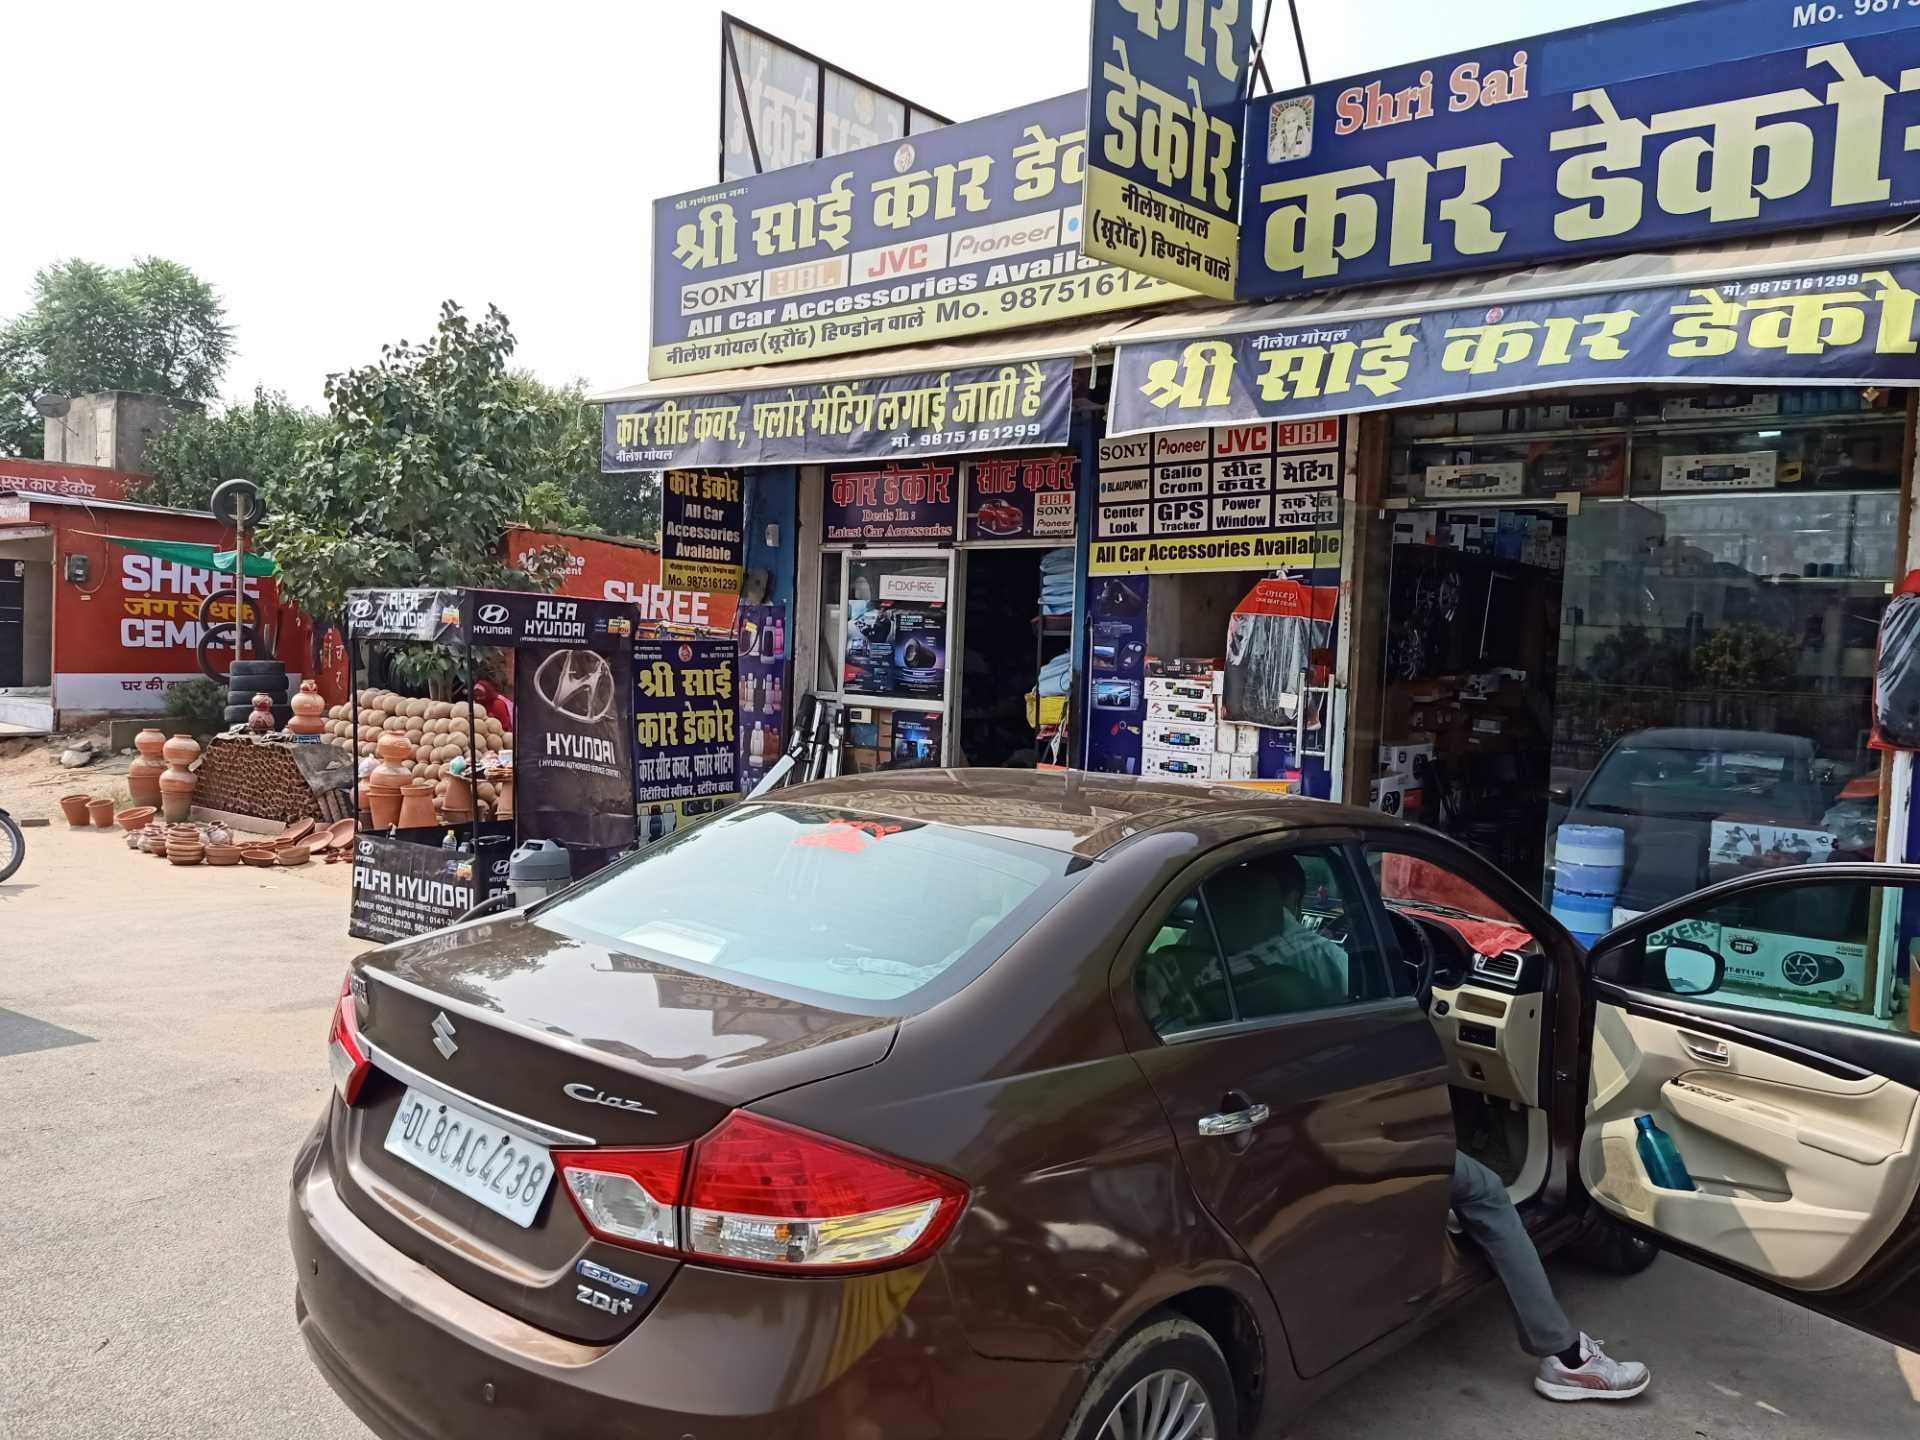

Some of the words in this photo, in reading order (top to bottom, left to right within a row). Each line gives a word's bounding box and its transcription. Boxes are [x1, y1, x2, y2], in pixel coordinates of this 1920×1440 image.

[1792, 3, 1844, 28] Mo.
[1335, 72, 1433, 136] Shri
[1448, 50, 1530, 113] Sai
[1103, 36, 1237, 212] डेकोर
[1259, 140, 1515, 280] कार
[1548, 41, 1920, 243] डेको
[672, 203, 738, 271] श्री
[752, 172, 856, 256] साई
[872, 156, 993, 230] कार
[1121, 182, 1167, 223] नीलेश
[1169, 204, 1211, 240] गोयल
[954, 225, 1056, 259] Pioneer
[868, 244, 928, 278] JVC
[1204, 257, 1231, 283] वाले
[769, 261, 842, 297] JBL
[683, 279, 759, 310] SONY
[687, 315, 722, 337] All
[728, 308, 777, 330] Car
[780, 272, 978, 323] Accessories
[1251, 333, 1300, 350] नीलेश
[1301, 328, 1351, 346] गोयल
[1723, 281, 1747, 298] मो.
[1748, 273, 1860, 296] 9875161299
[666, 344, 711, 365] नीलेश
[714, 335, 760, 357] गोयल
[888, 306, 926, 331] वाले
[937, 300, 989, 324] Mo.
[1139, 340, 1239, 409] श्री
[1255, 317, 1422, 402] साई
[1441, 308, 1641, 375] कार
[1667, 269, 1920, 358] डेको
[616, 414, 652, 448] कार
[653, 400, 692, 446] सीट
[693, 405, 746, 449] कवर,
[877, 372, 950, 434] लगाई
[952, 366, 1020, 424] जाती
[1020, 361, 1047, 417] है
[615, 448, 643, 463] नीलेश
[644, 449, 673, 461] गोयल
[919, 422, 1041, 447] 9875161299
[1217, 426, 1267, 454] JVC
[1281, 420, 1336, 446] JBL
[1099, 442, 1149, 462] SONY
[1157, 437, 1207, 456] Pioneer
[1160, 466, 1202, 480] Galio
[1221, 460, 1262, 478] सीट
[29, 479, 58, 493] कार
[59, 475, 97, 497] डेकोर
[669, 470, 699, 497] कार
[701, 468, 740, 503] डेकोर
[831, 471, 881, 507] कार
[881, 461, 955, 506] डेकोर
[1107, 479, 1149, 492] BLAUPUNKT
[1159, 481, 1203, 494] Crom
[1217, 477, 1267, 493] कवर
[685, 503, 702, 519] All
[704, 505, 725, 521] Car
[862, 509, 894, 522] Deals
[895, 508, 909, 521] In
[1037, 506, 1072, 516] SONY
[1103, 506, 1145, 520] Center
[1157, 501, 1204, 522] GPS
[1222, 498, 1261, 511] Power
[666, 521, 740, 543] Accessories
[828, 525, 864, 538] Latest
[864, 525, 885, 538] Car
[885, 523, 953, 538] Accessories
[1037, 519, 1072, 528] Pioneer
[1109, 521, 1138, 534] Look
[1160, 522, 1201, 532] Tracker
[1216, 514, 1266, 528] Window
[676, 542, 732, 561] Available
[1096, 546, 1116, 563] All
[1120, 545, 1146, 562] Car
[1149, 539, 1250, 562] Accessories
[1254, 535, 1341, 556] Available
[668, 574, 685, 586] Mo.
[687, 575, 737, 590] 9875161299
[888, 581, 936, 593] FOXFIRE
[1256, 585, 1298, 602] Concept
[123, 593, 179, 617] जंग
[388, 592, 419, 611] ALFA
[536, 600, 578, 621] ALFA
[473, 625, 513, 635] HYUNDAI
[524, 620, 586, 637] HYUNDAI
[120, 680, 141, 691] घर
[144, 676, 163, 691] की
[638, 661, 676, 697] श्री
[680, 660, 733, 700] साई
[636, 711, 678, 748] कार
[682, 699, 735, 745] डेकोर
[546, 732, 617, 765] HYUNDAI
[639, 759, 655, 782] कार
[655, 751, 671, 781] सीट
[353, 866, 392, 895] ALFA
[395, 874, 475, 912] HYUNDAI
[562, 1083, 658, 1115] Ciaz
[403, 1102, 548, 1208] DL8CAC4238
[589, 1267, 631, 1289] SHVS
